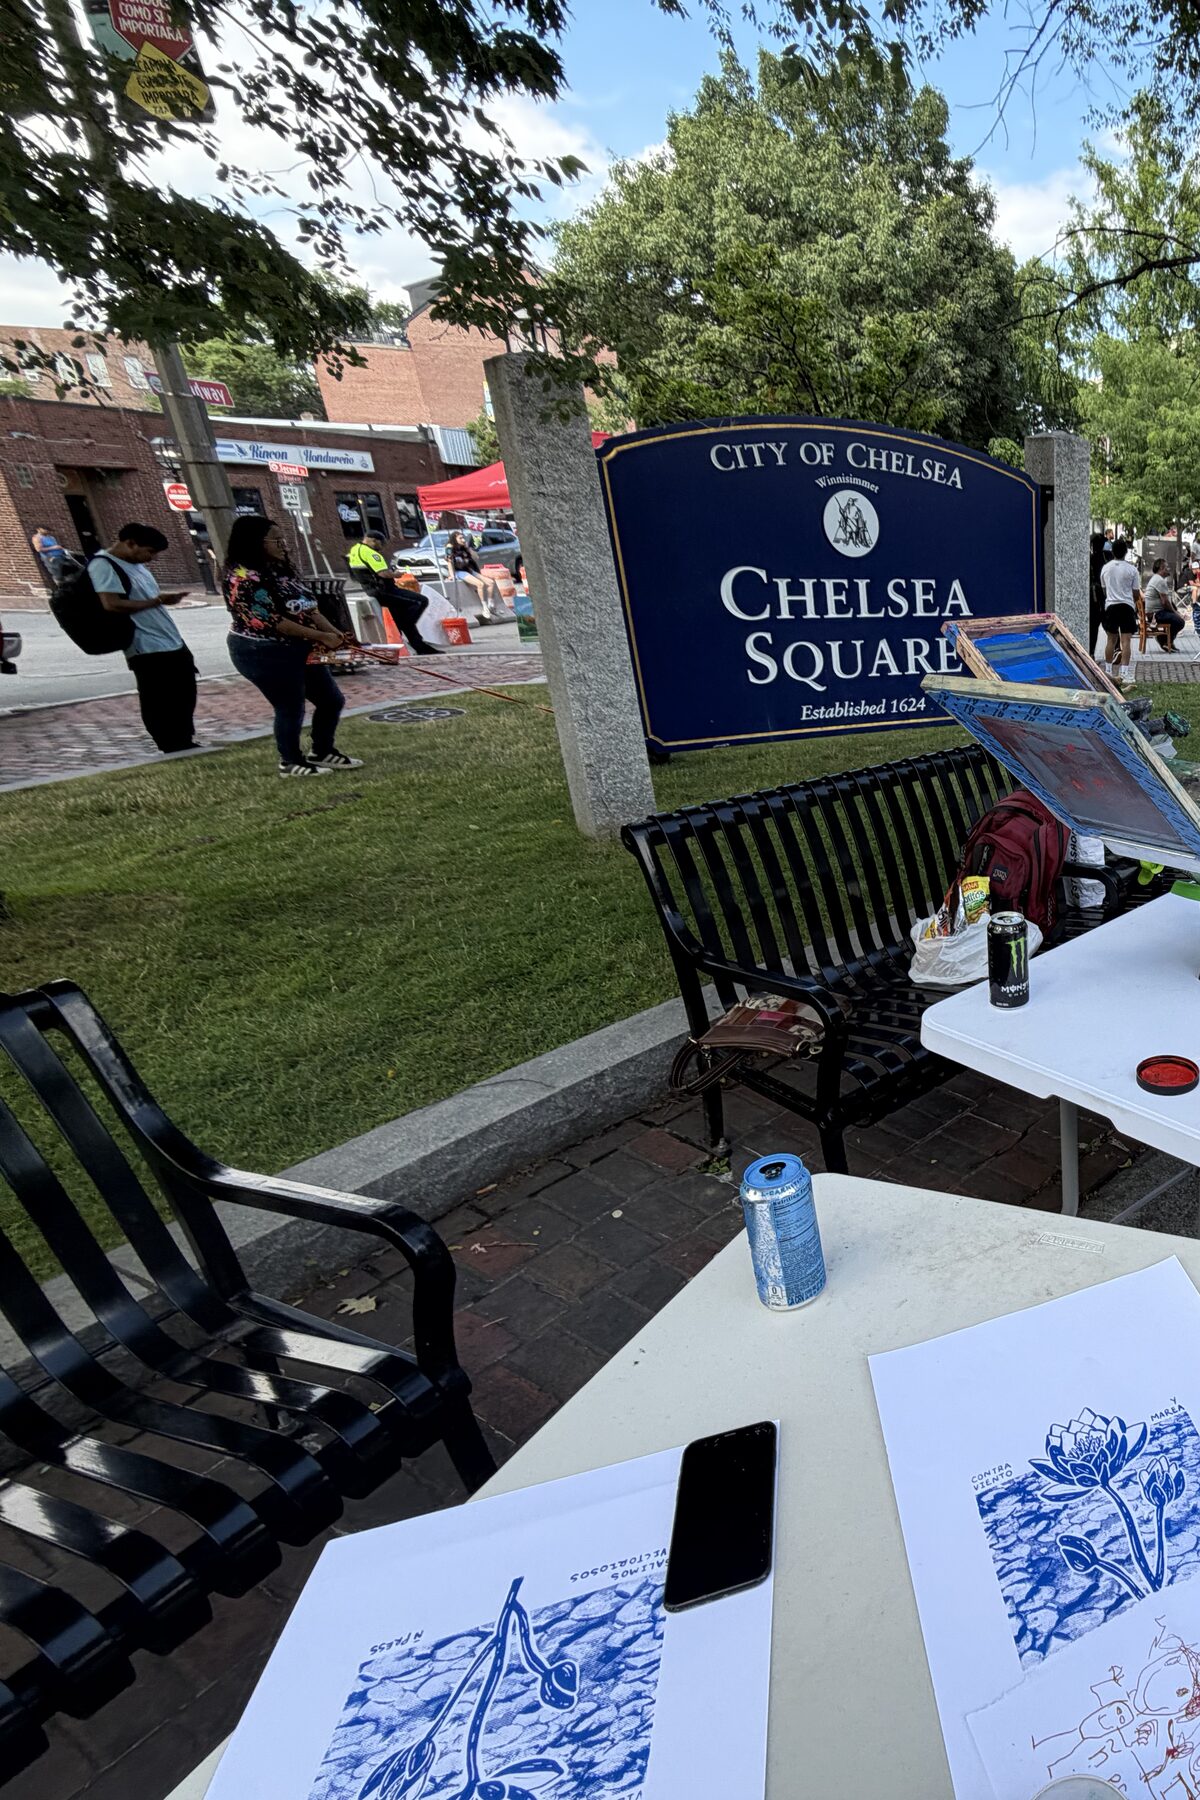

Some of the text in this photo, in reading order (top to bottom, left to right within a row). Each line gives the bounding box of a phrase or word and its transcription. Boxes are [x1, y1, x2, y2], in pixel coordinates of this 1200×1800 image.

[118, 2, 151, 21] COMO
[190, 382, 226, 405] dway
[249, 443, 354, 465] Rincon Hondureño
[710, 442, 963, 489] CITY OF CHELSEA
[815, 473, 880, 494] Winnisimmet
[720, 566, 973, 621] CHELSEA
[745, 631, 963, 691] SQUARE
[801, 697, 926, 720] Established 1624
[1169, 1396, 1177, 1405] Y
[1150, 1404, 1185, 1422] MAREA
[971, 1463, 1012, 1484] CONTRA
[973, 1470, 1013, 1492] VIENTO
[570, 1548, 667, 1583] VICTORIOSOS
[610, 1558, 669, 1581] SALIMOS
[370, 1632, 412, 1656] PRESS
